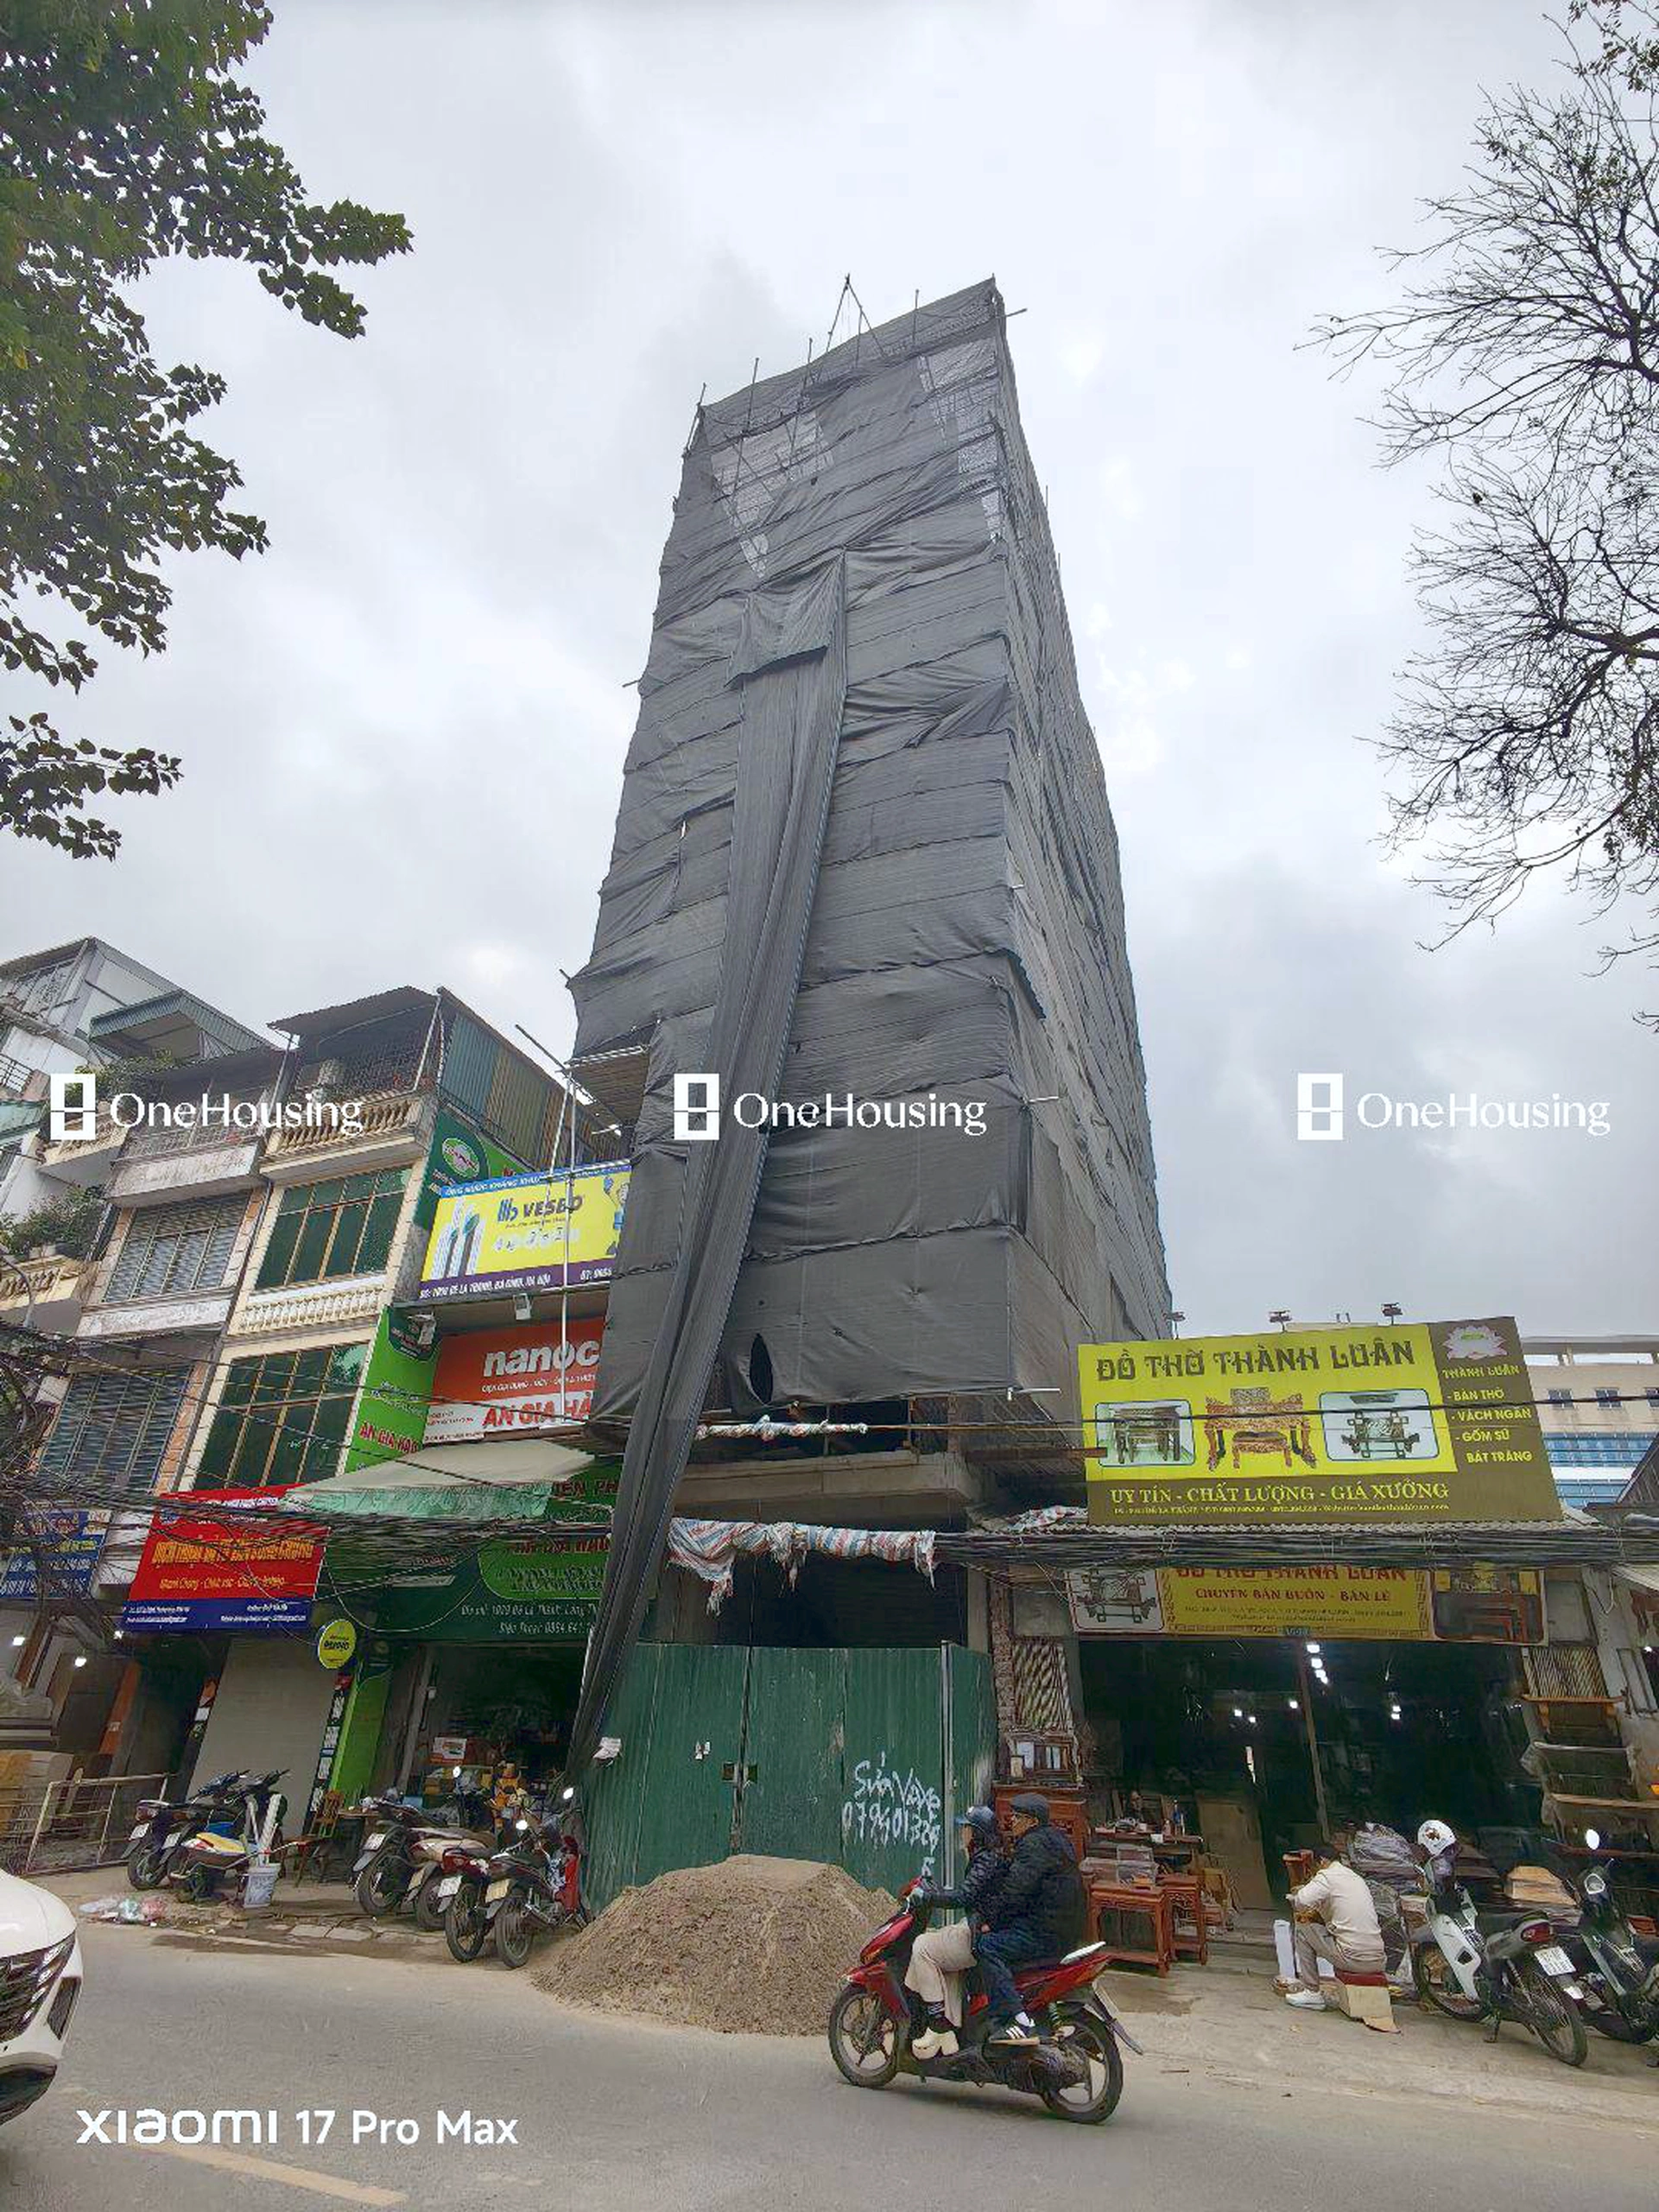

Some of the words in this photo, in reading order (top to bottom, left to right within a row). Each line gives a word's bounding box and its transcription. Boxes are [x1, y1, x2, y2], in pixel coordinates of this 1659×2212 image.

[1213, 1343, 1320, 1375] THÀNH
[1110, 1488, 1135, 1504] UY
[1139, 1484, 1172, 1503] TÍN
[1187, 1481, 1239, 1503] CHẤT
[1243, 1483, 1315, 1505] LƯỢNG
[1331, 1480, 1369, 1501] GIÁ
